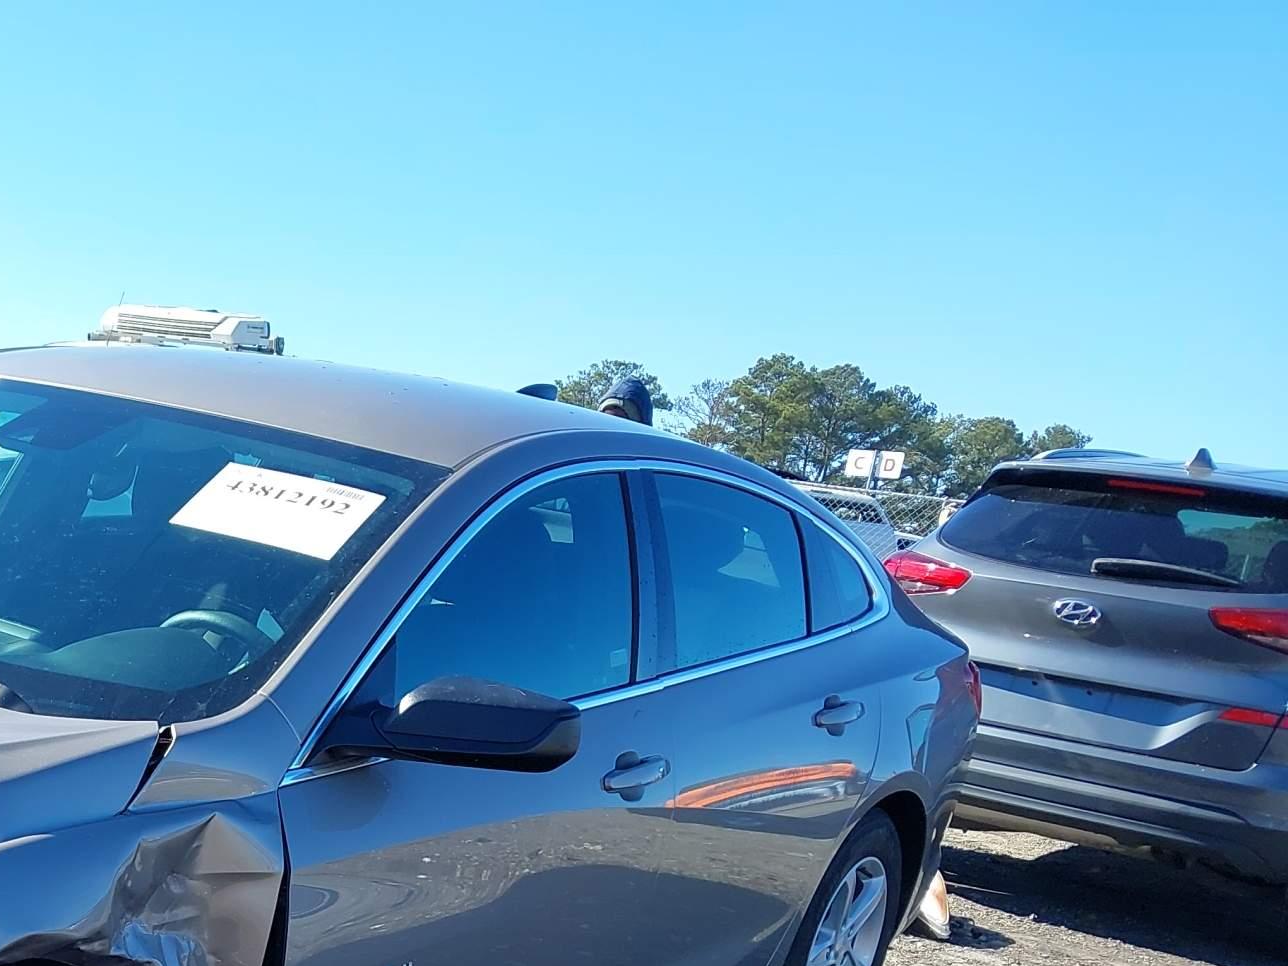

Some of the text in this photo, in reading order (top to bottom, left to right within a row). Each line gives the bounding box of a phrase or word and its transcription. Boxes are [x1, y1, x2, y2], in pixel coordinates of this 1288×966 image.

[854, 456, 865, 470] C
[883, 458, 896, 472] D
[227, 481, 350, 514] 43812192
